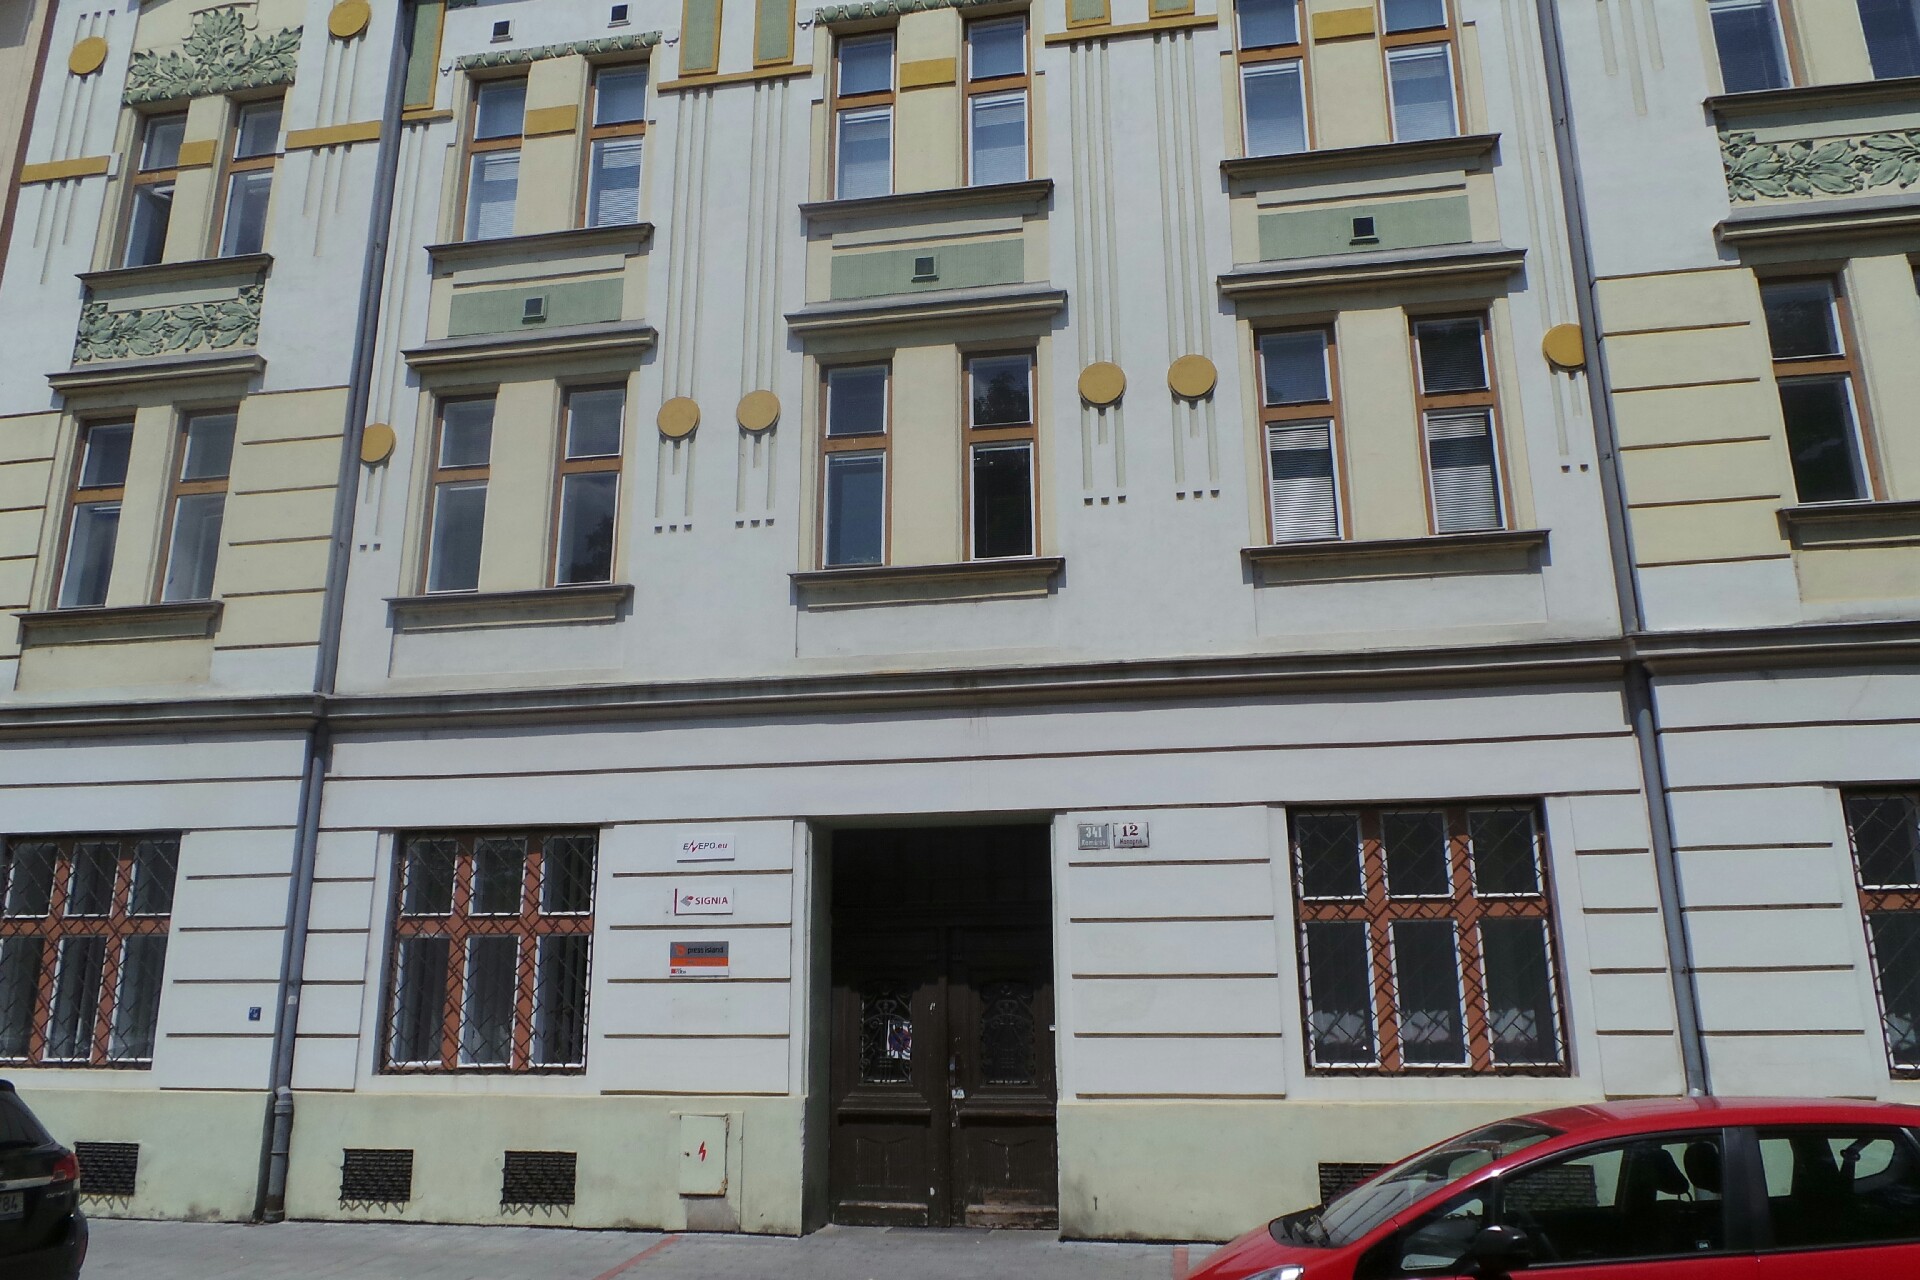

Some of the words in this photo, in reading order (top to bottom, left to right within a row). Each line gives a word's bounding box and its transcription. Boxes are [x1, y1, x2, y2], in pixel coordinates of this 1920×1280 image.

[1122, 824, 1139, 837] 12
[695, 896, 728, 905] SIGNIA
[687, 946, 704, 955] press
[704, 945, 724, 954] island
